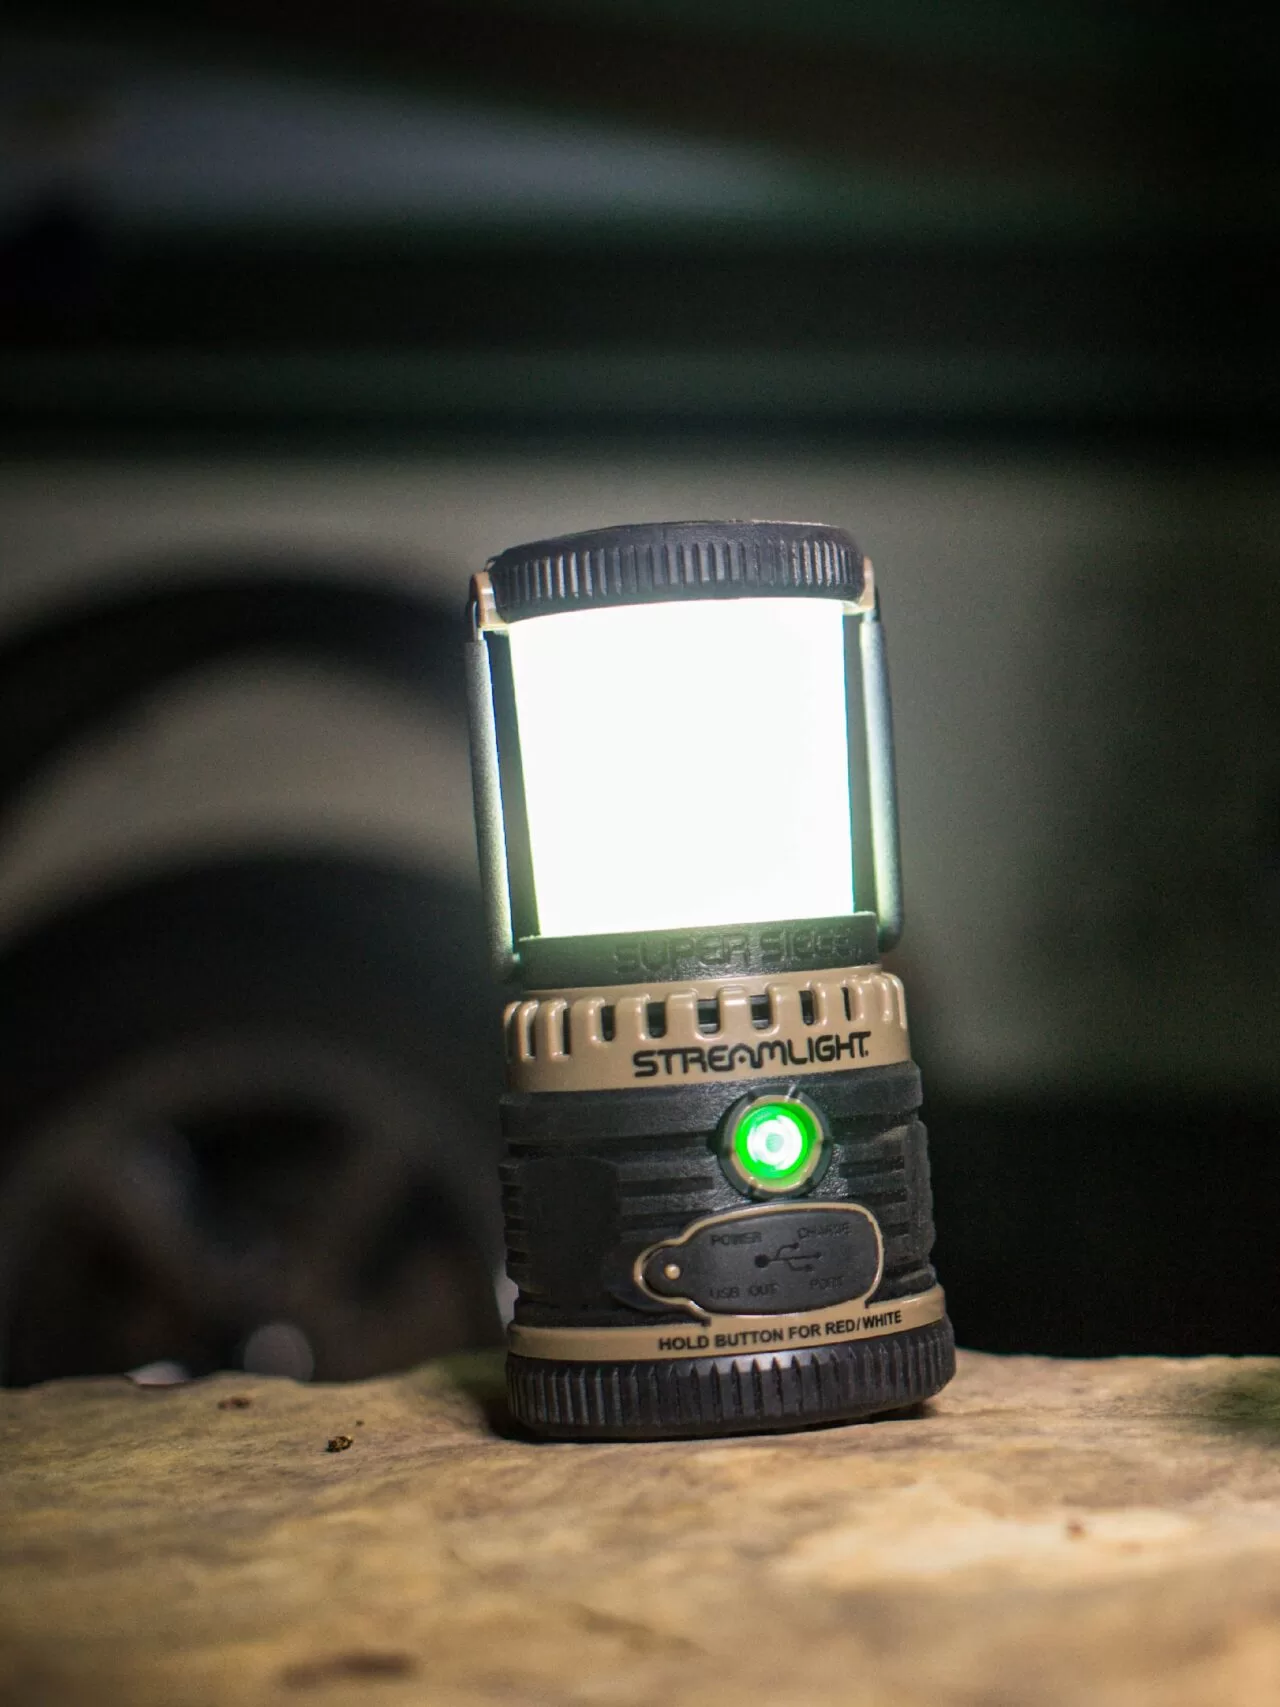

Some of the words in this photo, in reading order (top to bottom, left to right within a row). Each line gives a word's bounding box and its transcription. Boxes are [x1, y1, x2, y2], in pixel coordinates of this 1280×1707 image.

[612, 932, 751, 975] SUPER
[632, 1031, 871, 1077] STREAMLIGHT
[658, 1335, 710, 1351] HOLD
[715, 1328, 784, 1347] BUTTON
[789, 1322, 821, 1339] FOR
[825, 1310, 903, 1334] RED/WHITE
